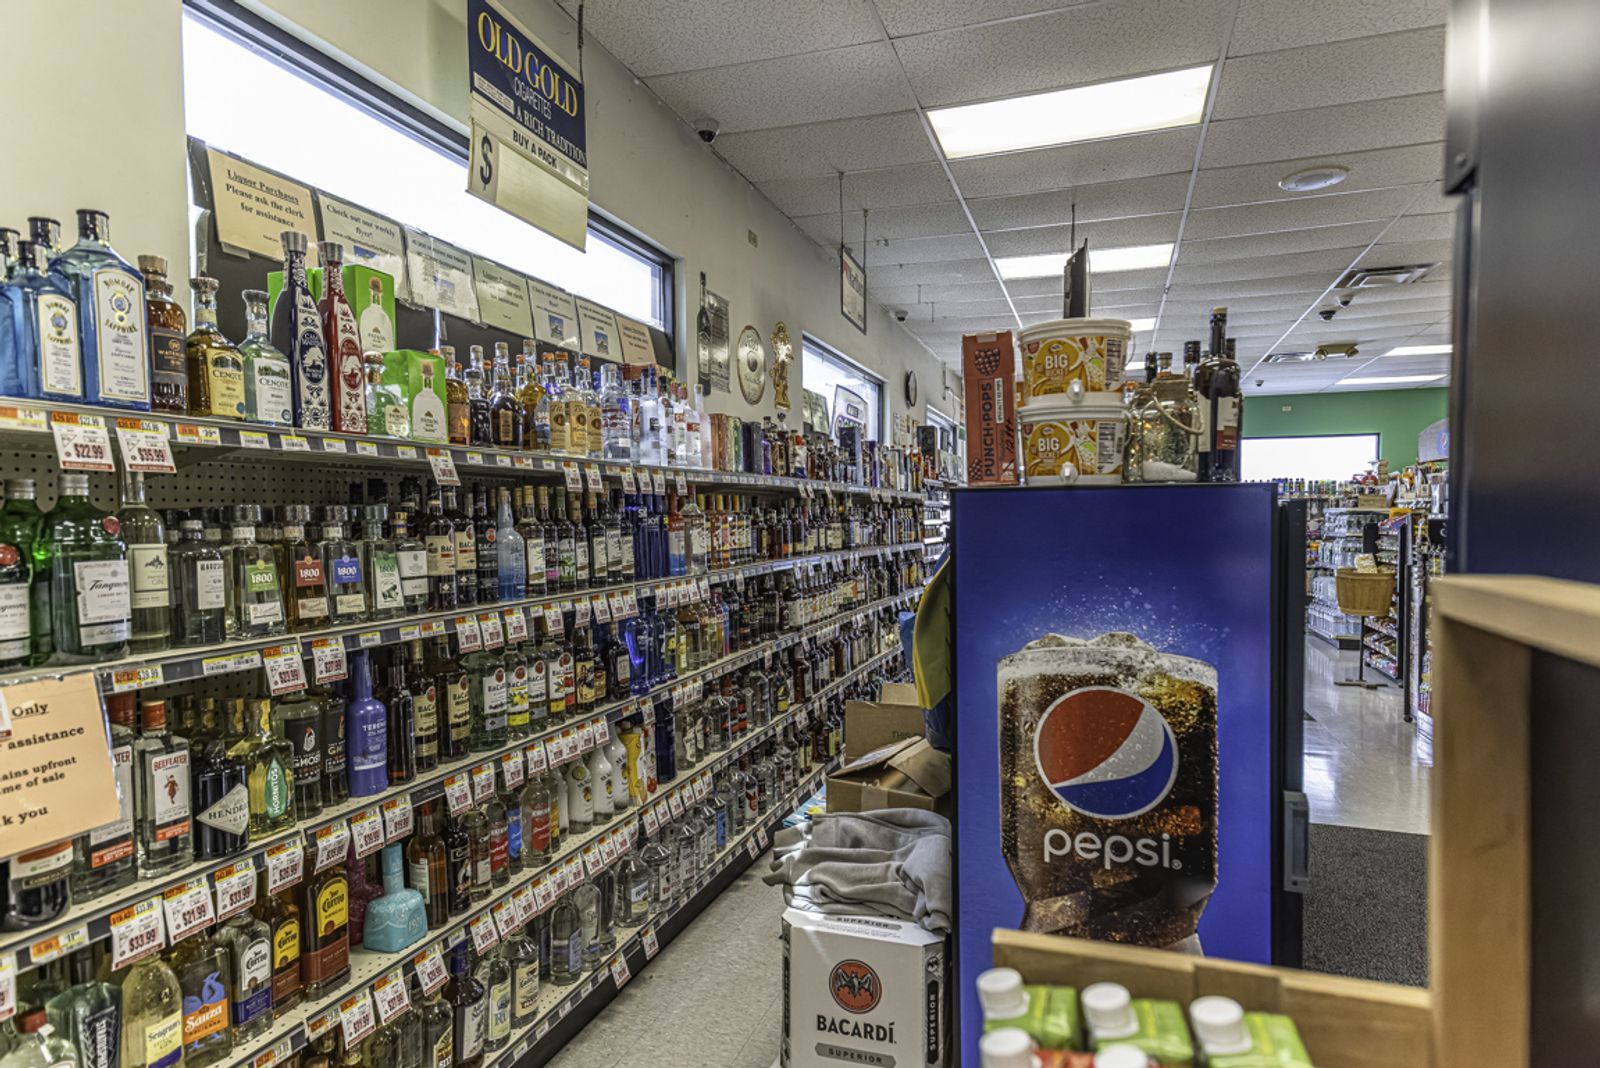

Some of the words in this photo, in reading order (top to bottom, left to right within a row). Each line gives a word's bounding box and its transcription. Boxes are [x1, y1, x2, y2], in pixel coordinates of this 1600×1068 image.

[478, 12, 522, 74] OLD
[525, 52, 578, 117] GOLD
[514, 76, 552, 120] CIGARETTES
[516, 106, 523, 121] A
[523, 110, 544, 138] RICH
[545, 126, 587, 166] TRADITION
[512, 130, 529, 150] BUY
[531, 143, 538, 155] A
[538, 147, 558, 168] PACK
[480, 131, 493, 191] $
[227, 169, 257, 189] Liquor
[260, 181, 299, 205] Purchases
[226, 183, 253, 199] Please
[255, 196, 269, 206] ask
[271, 201, 284, 211] the
[285, 206, 304, 219] clerk
[327, 204, 349, 219] Check
[241, 202, 254, 213] for
[256, 209, 295, 228] assistance
[103, 279, 135, 294] BOMBAY
[1045, 353, 1068, 370] BIG
[74, 443, 104, 460] $22.99
[1038, 437, 1060, 452] BIG
[252, 573, 273, 583] 1800
[300, 567, 320, 578] 1800
[337, 566, 357, 576] 1800
[11, 703, 48, 719] Only
[8, 725, 85, 750] assistance
[33, 755, 77, 776] upfront
[154, 754, 187, 771] BEEFEATER
[26, 777, 38, 788] of
[42, 771, 65, 784] sale
[272, 767, 280, 813] HORNITOS
[19, 806, 48, 824] you
[1043, 828, 1172, 870] pepsi
[182, 904, 206, 927] $21.99
[129, 928, 156, 952] $33.99
[185, 1005, 223, 1033] Sauza
[829, 1048, 882, 1064] SUPERIOR
